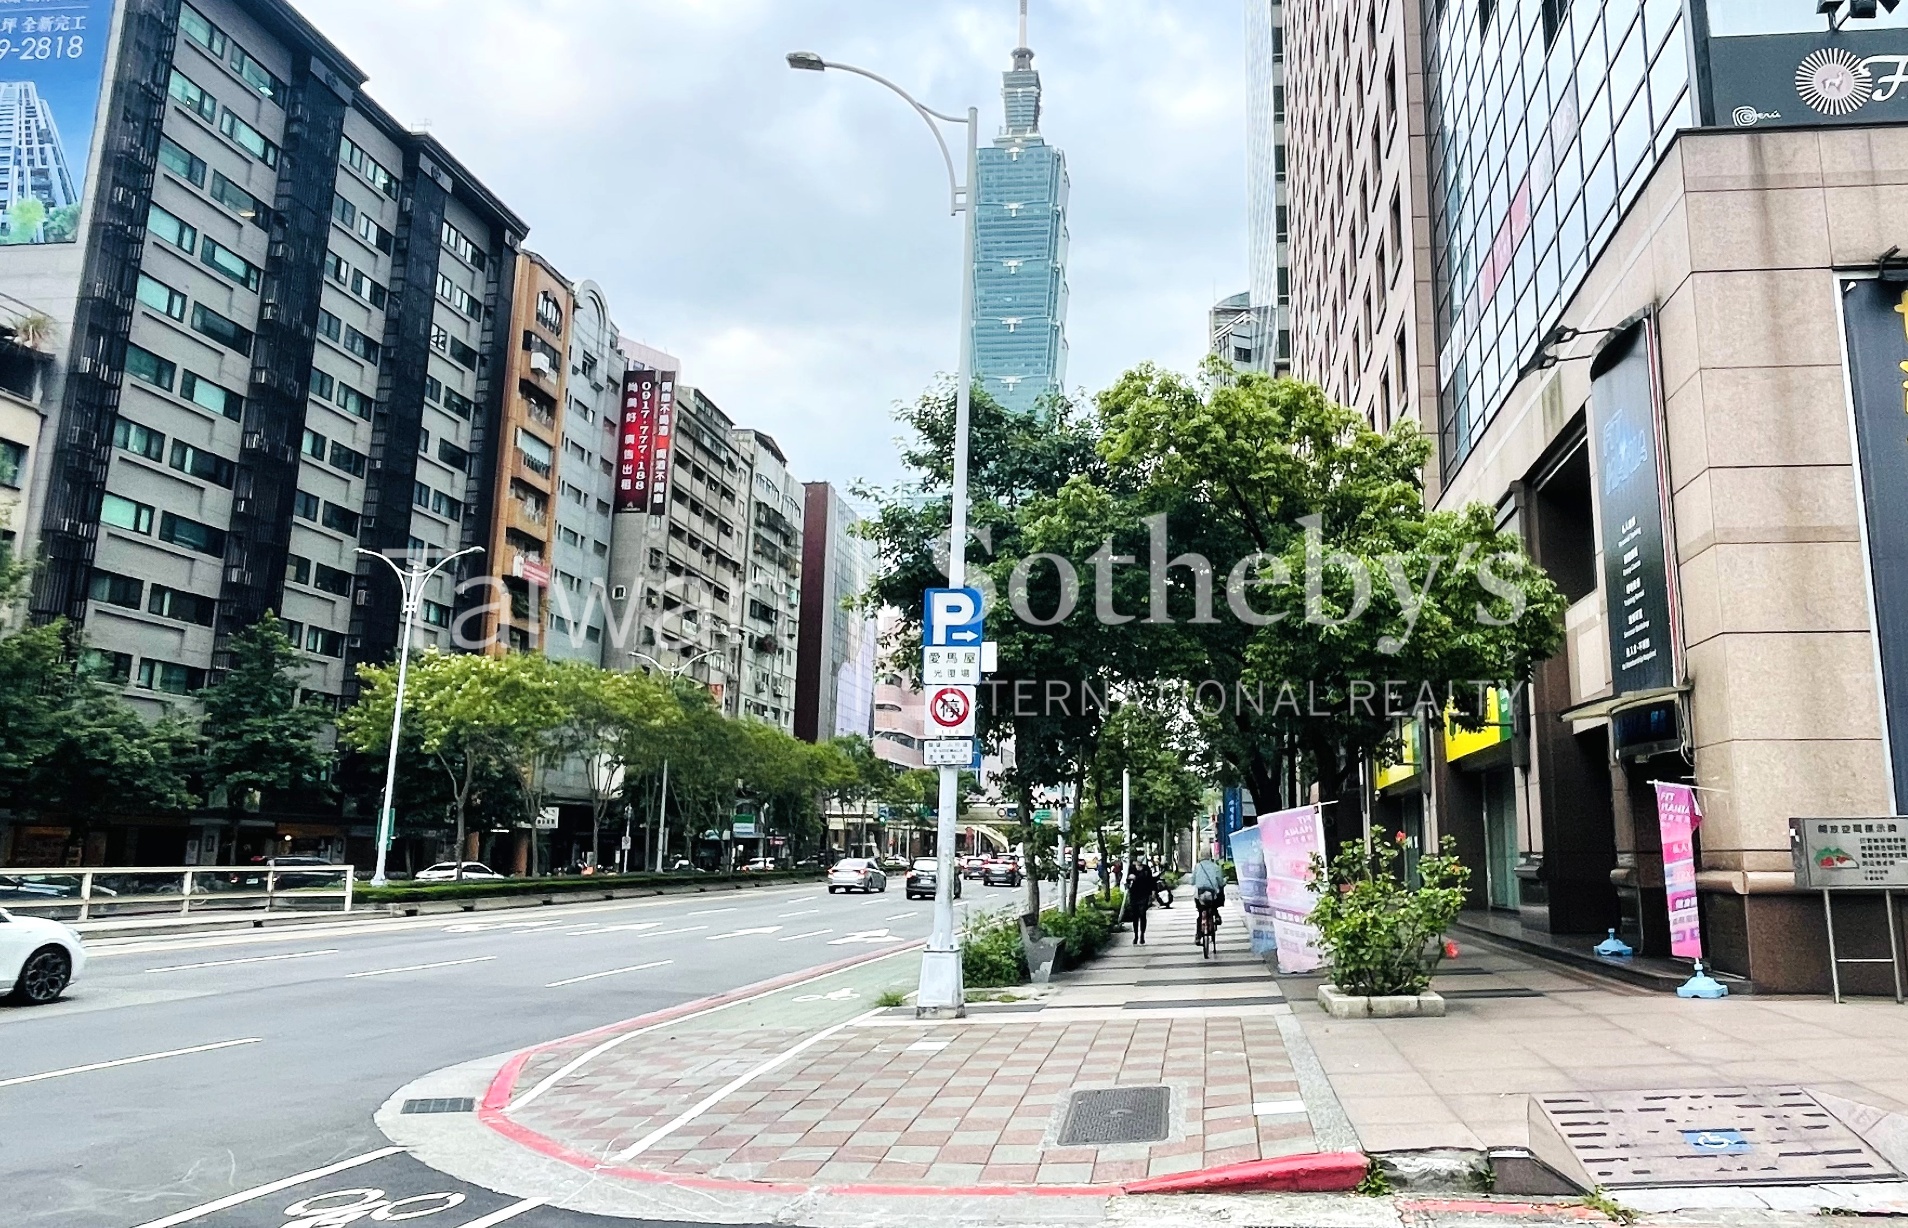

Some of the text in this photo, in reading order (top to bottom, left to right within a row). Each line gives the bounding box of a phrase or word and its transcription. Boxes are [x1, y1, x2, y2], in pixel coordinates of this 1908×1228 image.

[21, 15, 87, 33] 全新完工
[0, 35, 84, 60] 9-2818
[933, 592, 975, 645] P
[940, 698, 960, 718] 停
